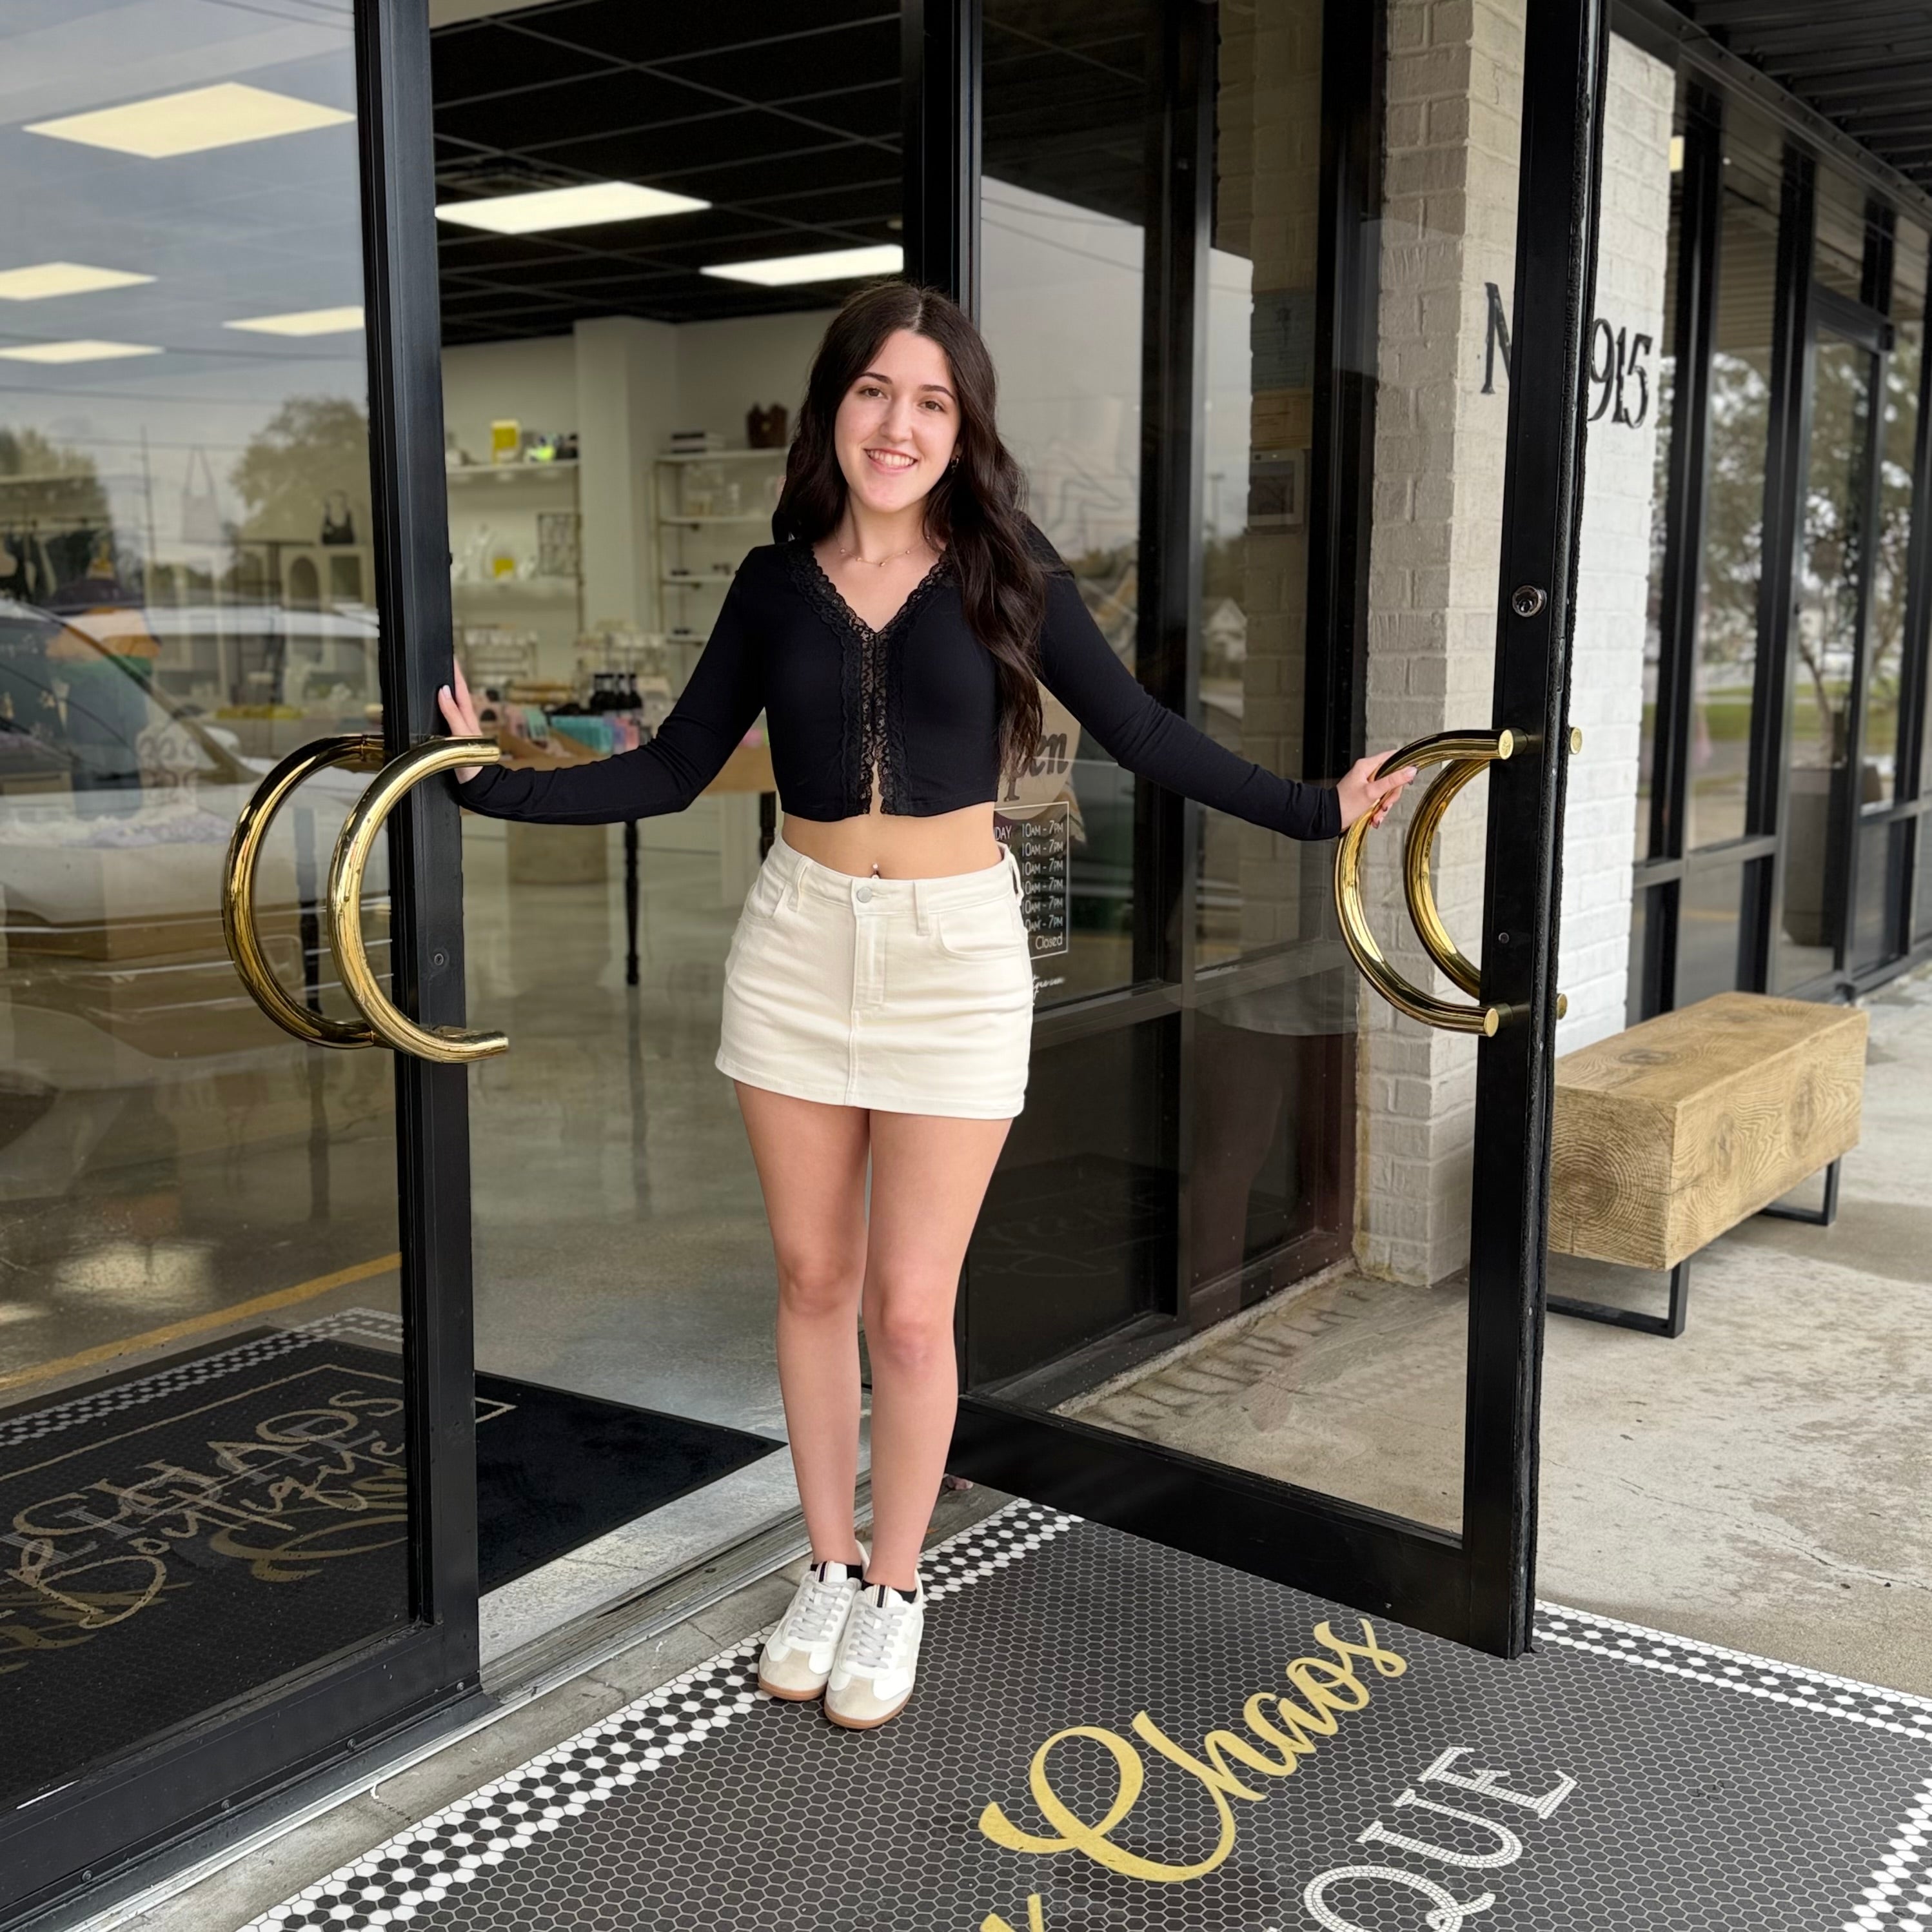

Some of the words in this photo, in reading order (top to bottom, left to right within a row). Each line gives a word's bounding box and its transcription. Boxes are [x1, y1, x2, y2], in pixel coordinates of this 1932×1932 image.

[1587, 318, 1653, 428] 915
[994, 825, 1012, 840] DAY
[1021, 822, 1041, 838] 10AM
[1049, 820, 1063, 835] 7PM
[1021, 842, 1041, 857] 10AM
[1049, 838, 1063, 853] 7PM
[1021, 861, 1041, 876] 10AM
[1049, 858, 1063, 872] 7PM
[1049, 876, 1063, 891] 7PM
[1021, 900, 1041, 914] 10AM
[1049, 895, 1063, 910] 7PM
[1025, 919, 1041, 932] 0AM
[1049, 914, 1063, 929] 7PM
[1035, 931, 1063, 950] Closed
[978, 1617, 1407, 1882] Chaos
[1303, 1746, 1579, 1932] QUE
